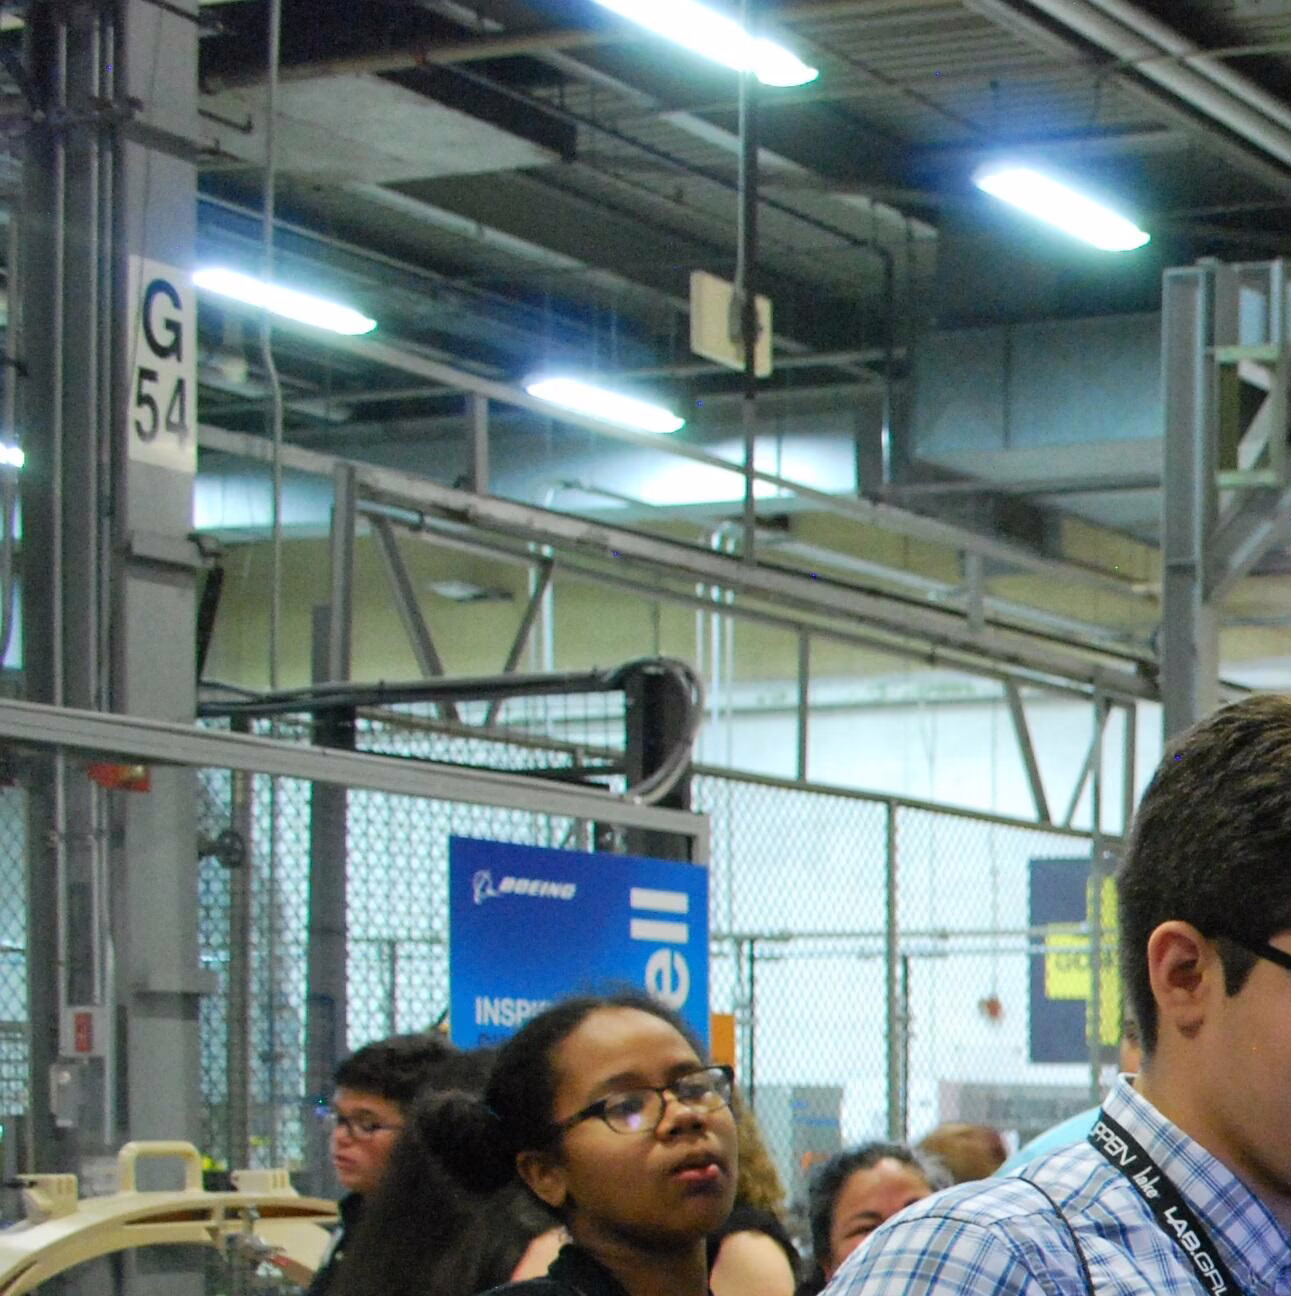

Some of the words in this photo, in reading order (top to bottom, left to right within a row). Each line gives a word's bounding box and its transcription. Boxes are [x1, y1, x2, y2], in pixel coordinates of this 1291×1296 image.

[143, 277, 183, 363] G
[134, 366, 188, 448] 54
[499, 876, 577, 901] BOEING
[1132, 1165, 1161, 1200] lake
